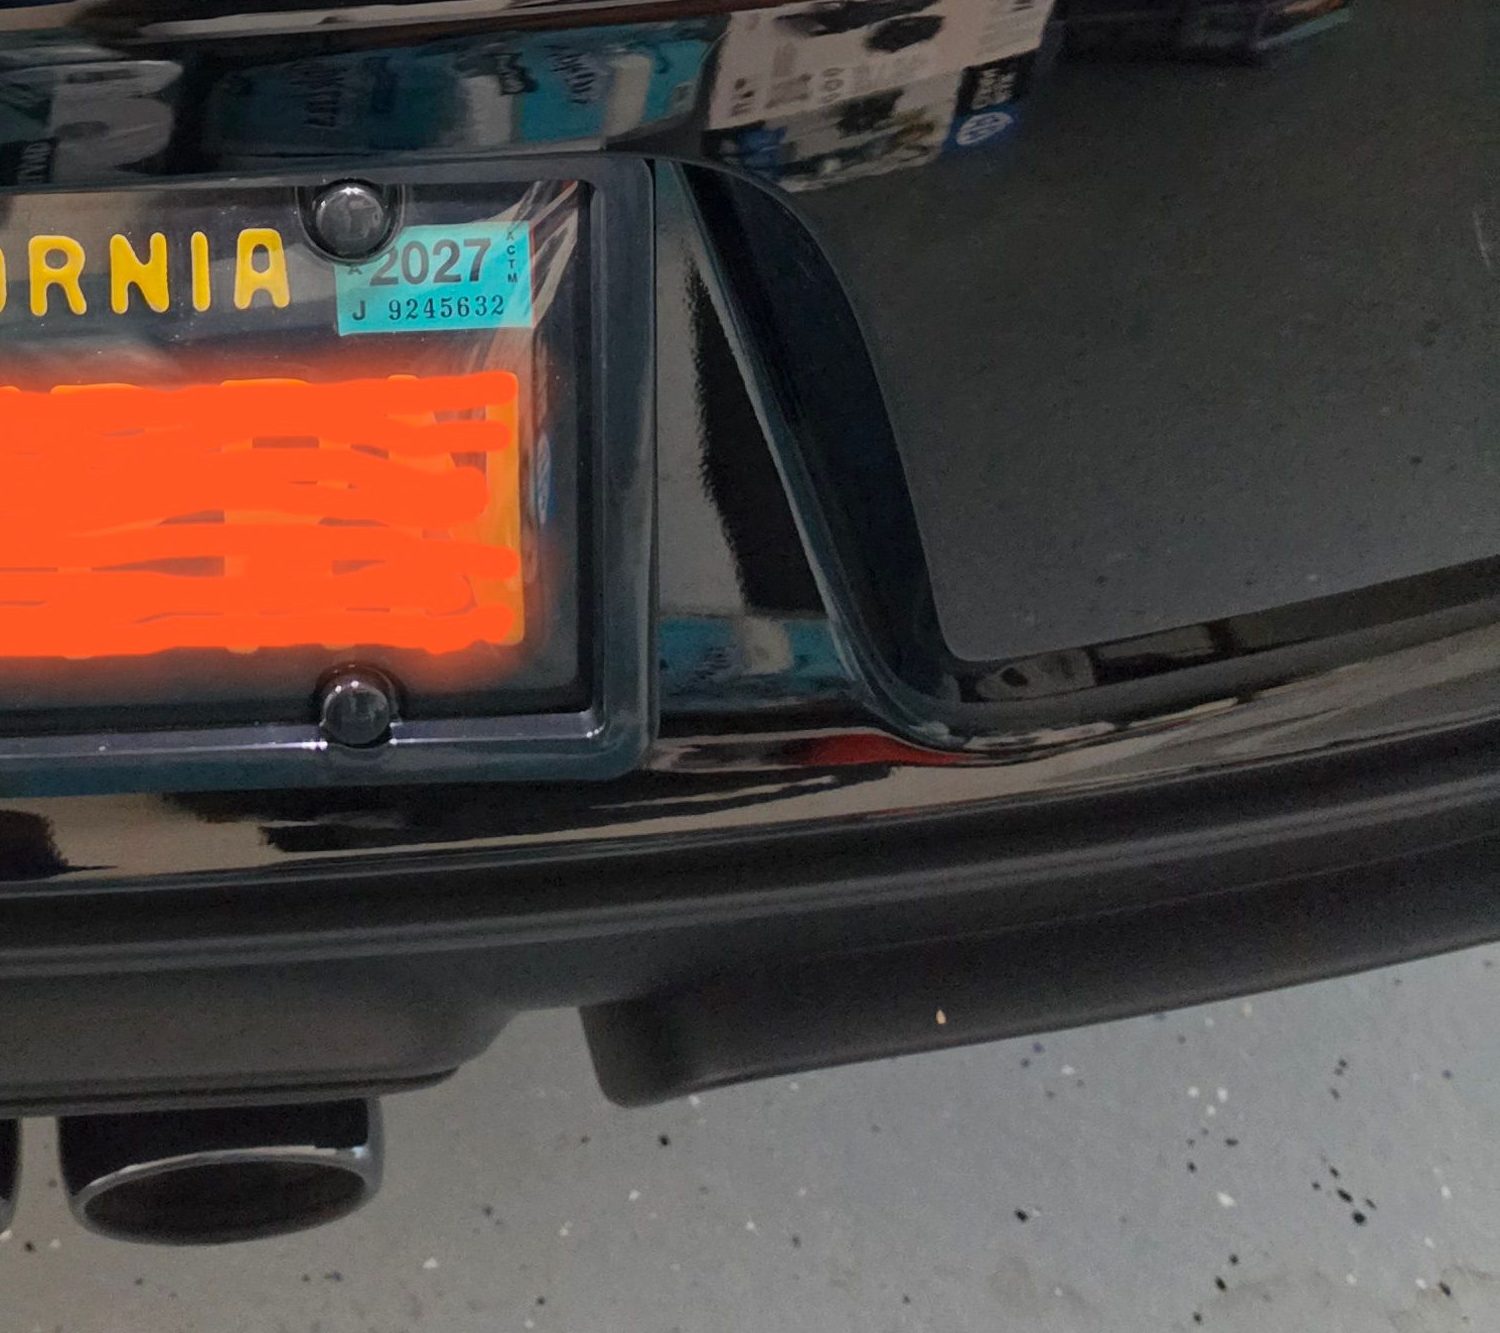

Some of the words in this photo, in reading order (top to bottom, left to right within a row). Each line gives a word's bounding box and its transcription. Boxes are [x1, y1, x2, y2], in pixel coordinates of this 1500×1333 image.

[369, 238, 492, 287] 2027
[352, 300, 367, 321] J
[388, 294, 505, 321] 9245632
